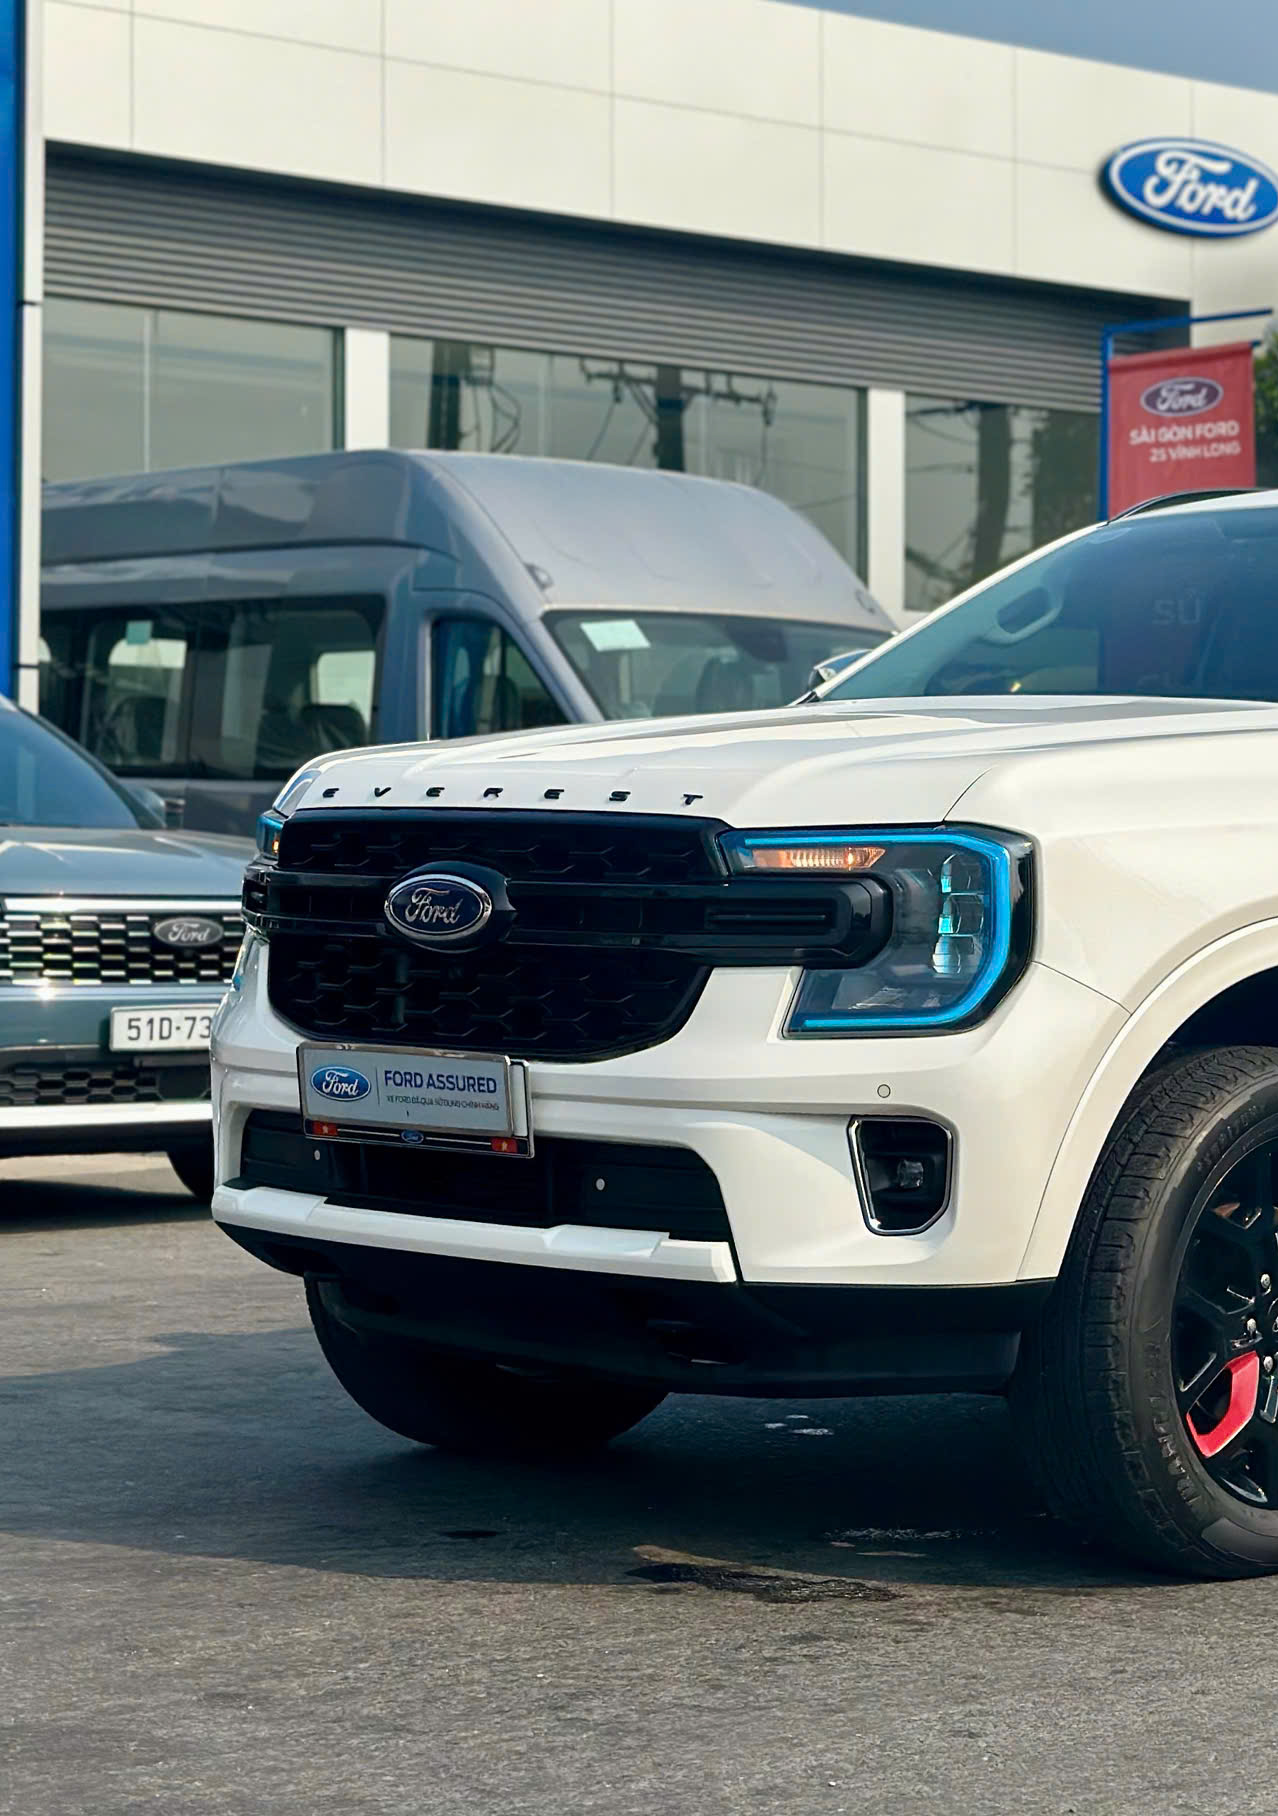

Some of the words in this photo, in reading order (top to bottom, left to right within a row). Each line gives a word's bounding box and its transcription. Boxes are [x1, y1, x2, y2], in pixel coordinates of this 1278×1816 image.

[1143, 149, 1260, 221] Ford
[1195, 419, 1240, 440] FORD
[322, 786, 704, 806] EVEREST
[404, 887, 464, 925] Ford
[384, 1070, 424, 1089] FORD
[426, 1073, 497, 1094] ASSURED
